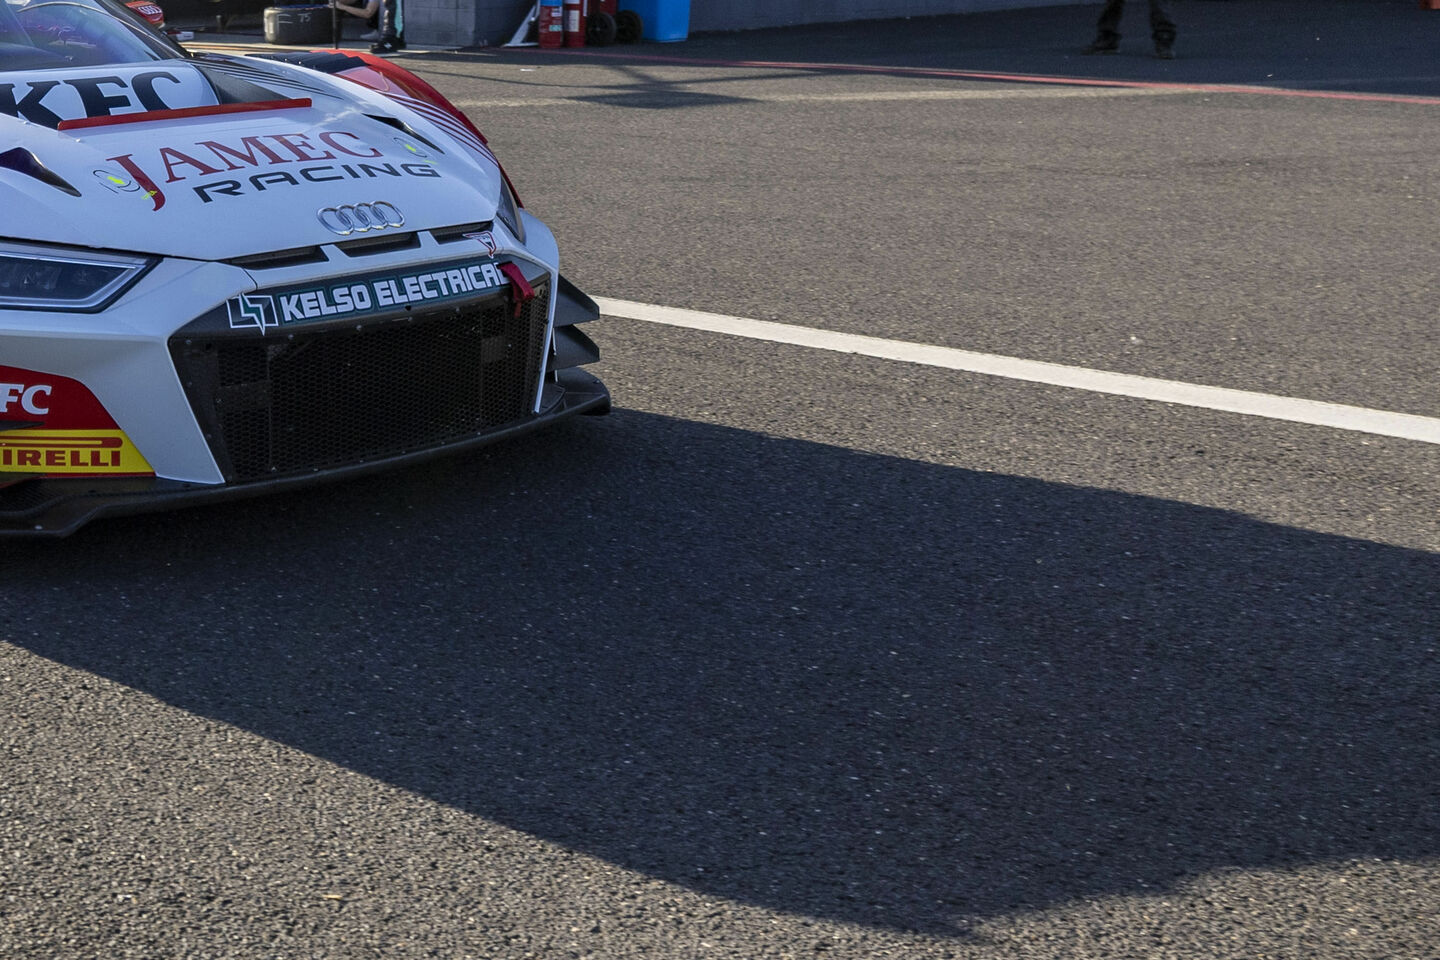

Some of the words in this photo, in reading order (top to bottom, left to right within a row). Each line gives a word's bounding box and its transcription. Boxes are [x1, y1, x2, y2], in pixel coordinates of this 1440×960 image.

[107, 131, 383, 212] JAMEC
[193, 162, 441, 204] RACING
[280, 285, 371, 321] KELSO
